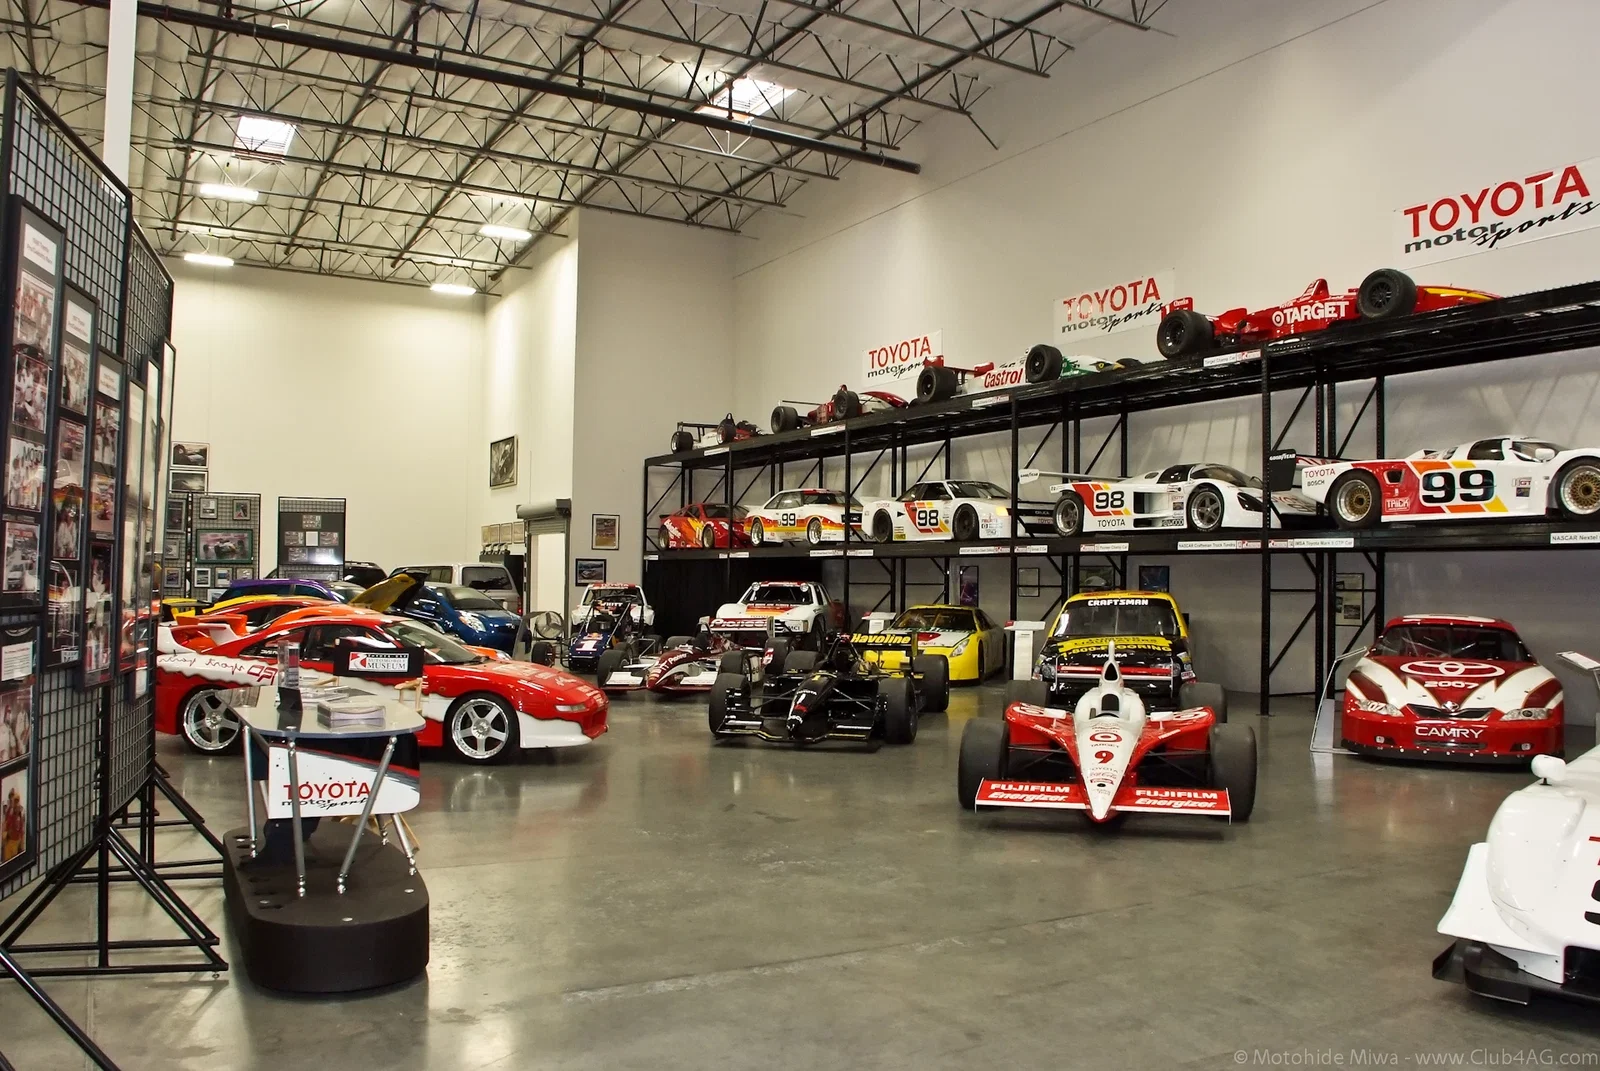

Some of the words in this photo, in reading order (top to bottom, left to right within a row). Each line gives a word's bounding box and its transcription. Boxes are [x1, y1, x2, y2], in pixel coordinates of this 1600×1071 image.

[1403, 165, 1591, 238] TOYOTA
[1404, 221, 1503, 253] motor
[1469, 199, 1600, 249] sports
[1063, 277, 1161, 322] TOYOTA
[1061, 313, 1117, 333] motor
[1100, 302, 1164, 333] sports
[1283, 301, 1350, 324] TARGET
[868, 336, 931, 369] TOYOTA
[867, 364, 903, 378] motor
[893, 356, 927, 379] spor
[984, 368, 1024, 388] Castrol
[1269, 453, 1296, 461] GOODYEAR
[1305, 468, 1336, 478] TOYOTA
[1422, 470, 1495, 503] 99
[1095, 490, 1125, 509] 98
[782, 513, 796, 526] 99
[917, 510, 939, 526] 98
[1097, 519, 1126, 528] TOYOTA
[1088, 599, 1149, 607] CRAFTSMAN
[576, 641, 598, 651] 1
[851, 633, 912, 644] Havoline
[1061, 644, 1172, 660] 1-800-FOORING
[1424, 680, 1479, 689] 2007
[1415, 726, 1484, 739] CAMRY
[1094, 750, 1115, 764] 9
[283, 782, 371, 799] TOYOTA
[990, 783, 1070, 793] FUJIFILM
[1135, 789, 1218, 799] FUJIFILM
[320, 797, 369, 810] sport
